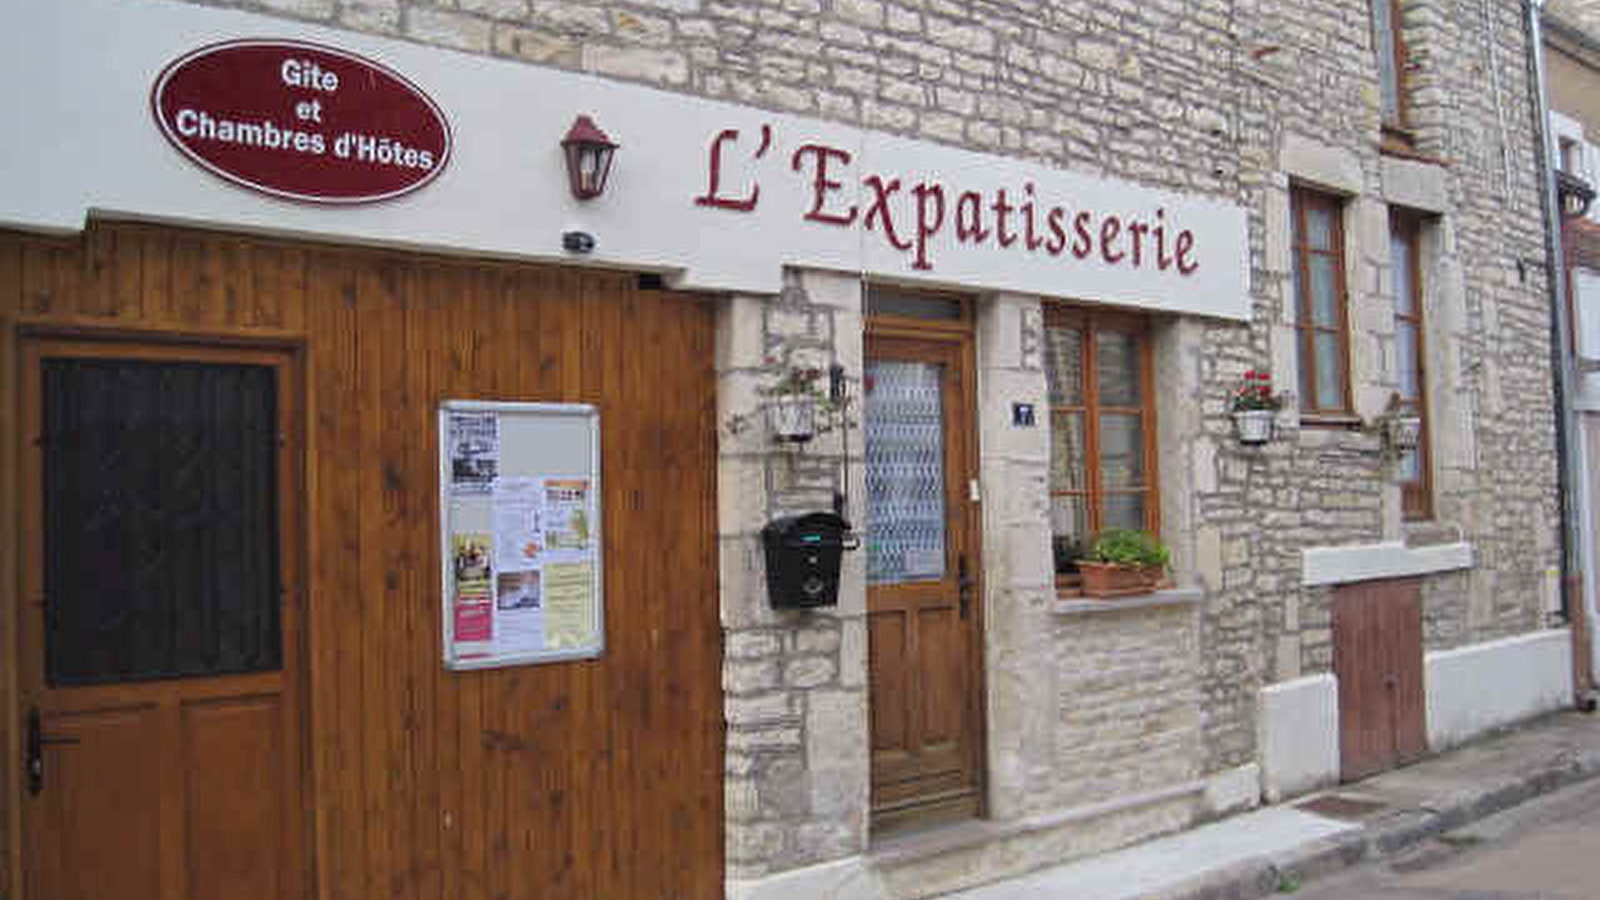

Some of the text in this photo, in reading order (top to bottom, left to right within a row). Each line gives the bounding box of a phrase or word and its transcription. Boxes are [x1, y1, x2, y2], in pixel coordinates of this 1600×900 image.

[281, 59, 339, 91] Gite
[295, 99, 321, 122] et
[176, 109, 326, 155] Chambres
